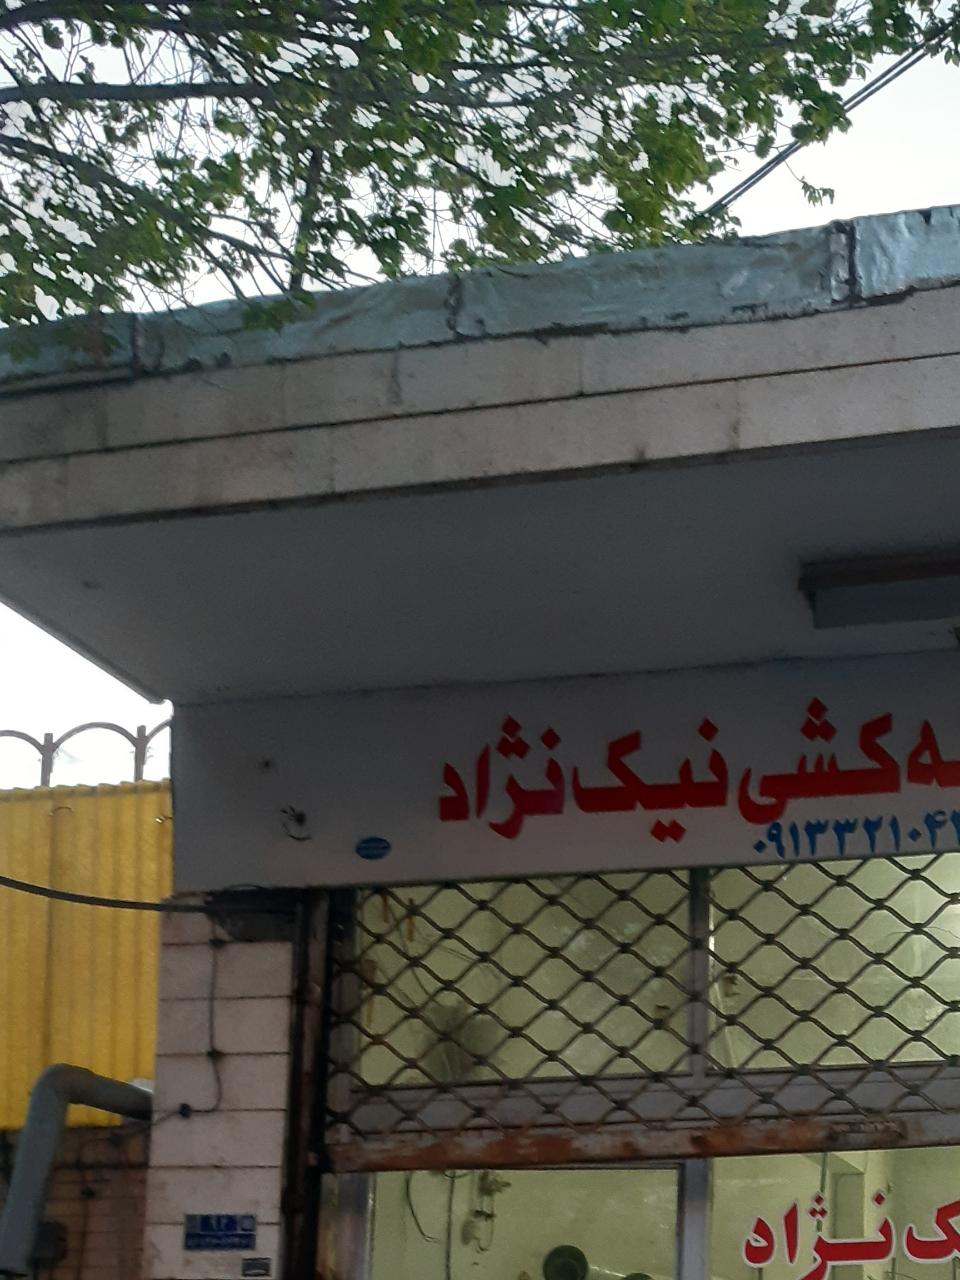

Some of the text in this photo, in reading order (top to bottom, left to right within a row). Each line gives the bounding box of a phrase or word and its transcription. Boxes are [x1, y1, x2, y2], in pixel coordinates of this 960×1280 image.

[438, 714, 566, 840] نژاد
[571, 716, 729, 843] نیک
[738, 696, 901, 825] کشی
